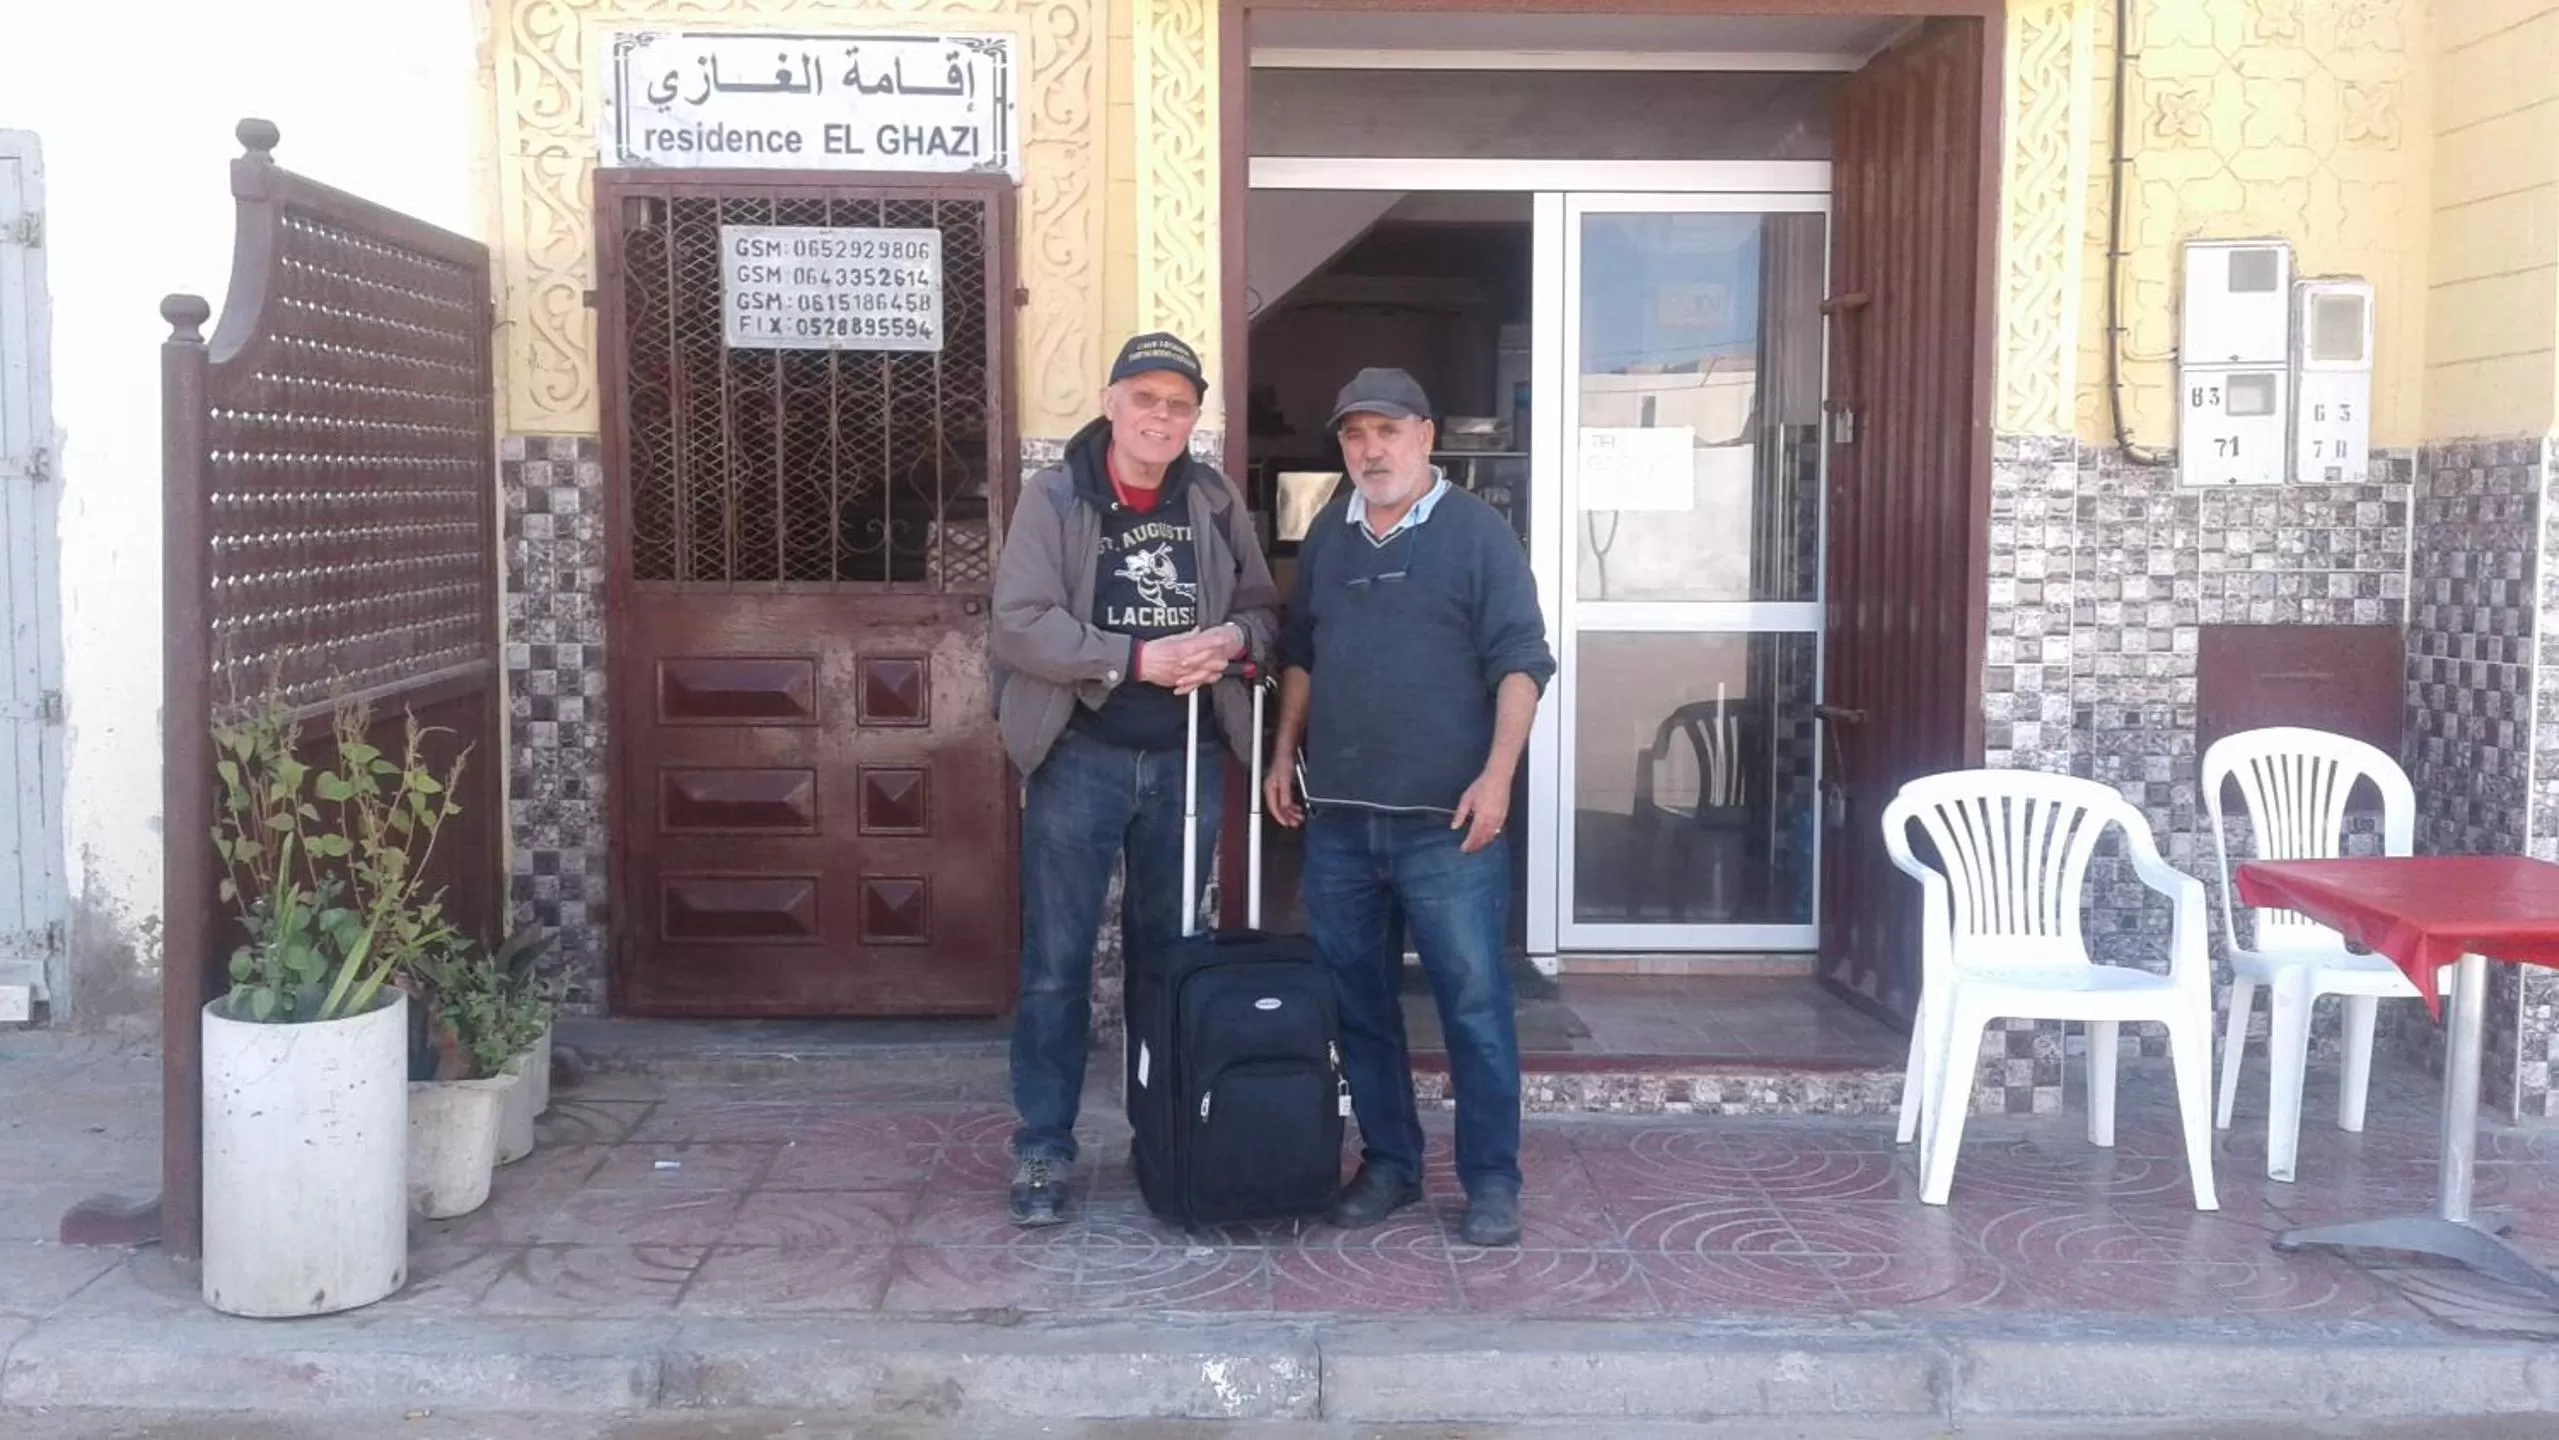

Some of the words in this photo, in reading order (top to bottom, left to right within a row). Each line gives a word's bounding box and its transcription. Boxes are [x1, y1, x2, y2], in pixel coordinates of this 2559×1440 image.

[647, 53, 824, 112] الغازي
[843, 46, 976, 112] إقامة
[644, 122, 802, 153] residence
[824, 123, 864, 156] EL
[877, 125, 979, 157] GHAZI
[793, 239, 930, 260] 0652929806
[794, 267, 930, 287] 0643352614
[798, 293, 932, 312] 0615186458
[796, 317, 933, 340] 0528895594
[2213, 435, 2240, 458] 71
